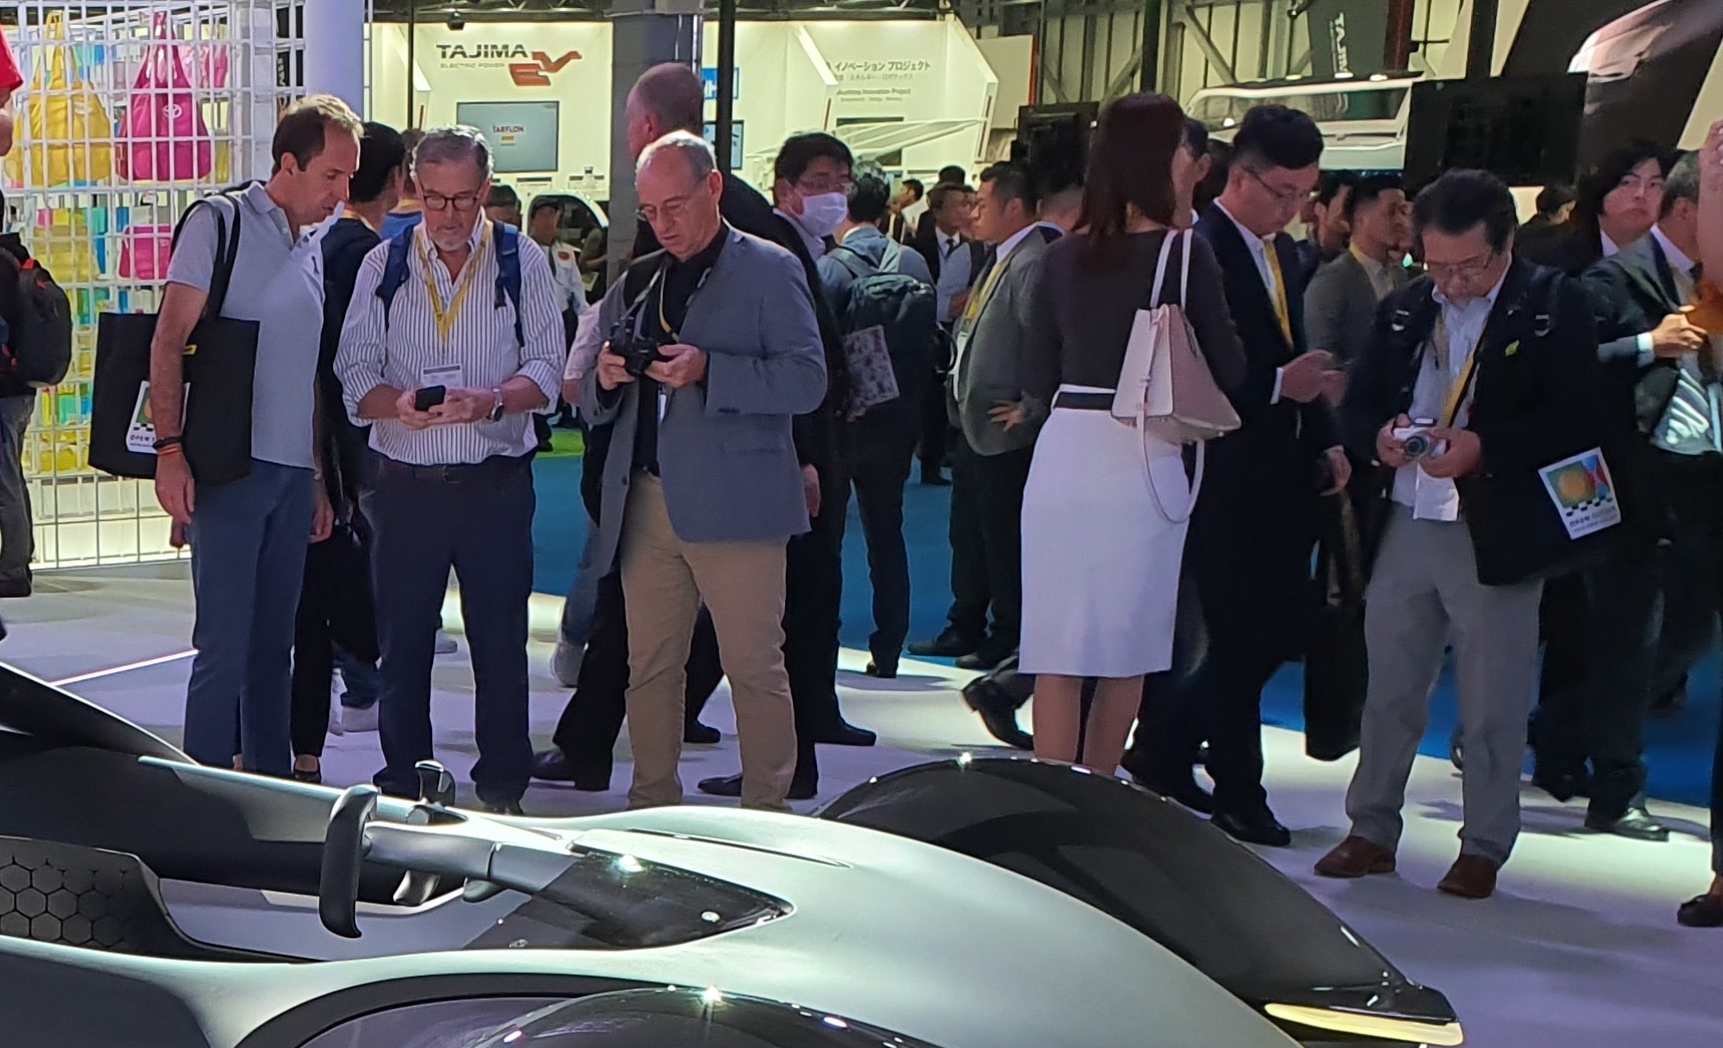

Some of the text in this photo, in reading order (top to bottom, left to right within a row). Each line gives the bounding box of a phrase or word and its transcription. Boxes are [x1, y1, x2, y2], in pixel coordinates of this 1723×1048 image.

[1334, 12, 1349, 72] TAJIM
[436, 44, 528, 59] TAJIMA
[888, 61, 931, 71] プロジェクト
